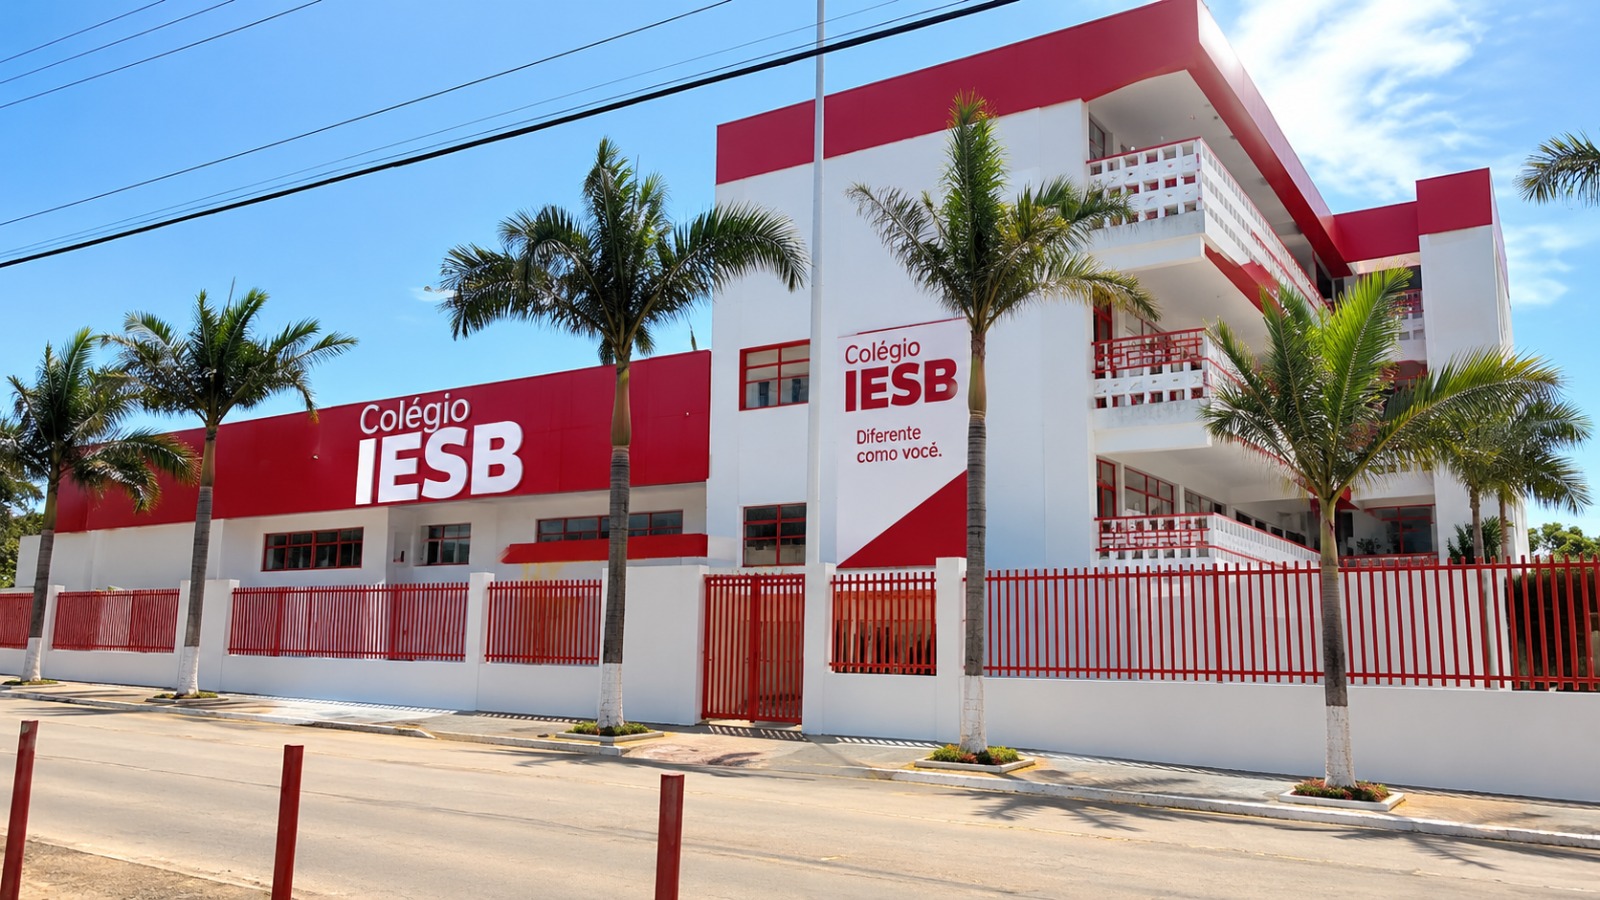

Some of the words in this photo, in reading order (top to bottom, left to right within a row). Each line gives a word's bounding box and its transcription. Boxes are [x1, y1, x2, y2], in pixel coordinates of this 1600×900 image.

[845, 338, 921, 364] Colégio
[845, 358, 959, 412] IESB
[360, 393, 471, 434] Colégio
[856, 426, 921, 445] Diferente
[355, 420, 524, 505] IESB
[856, 449, 898, 463] como
